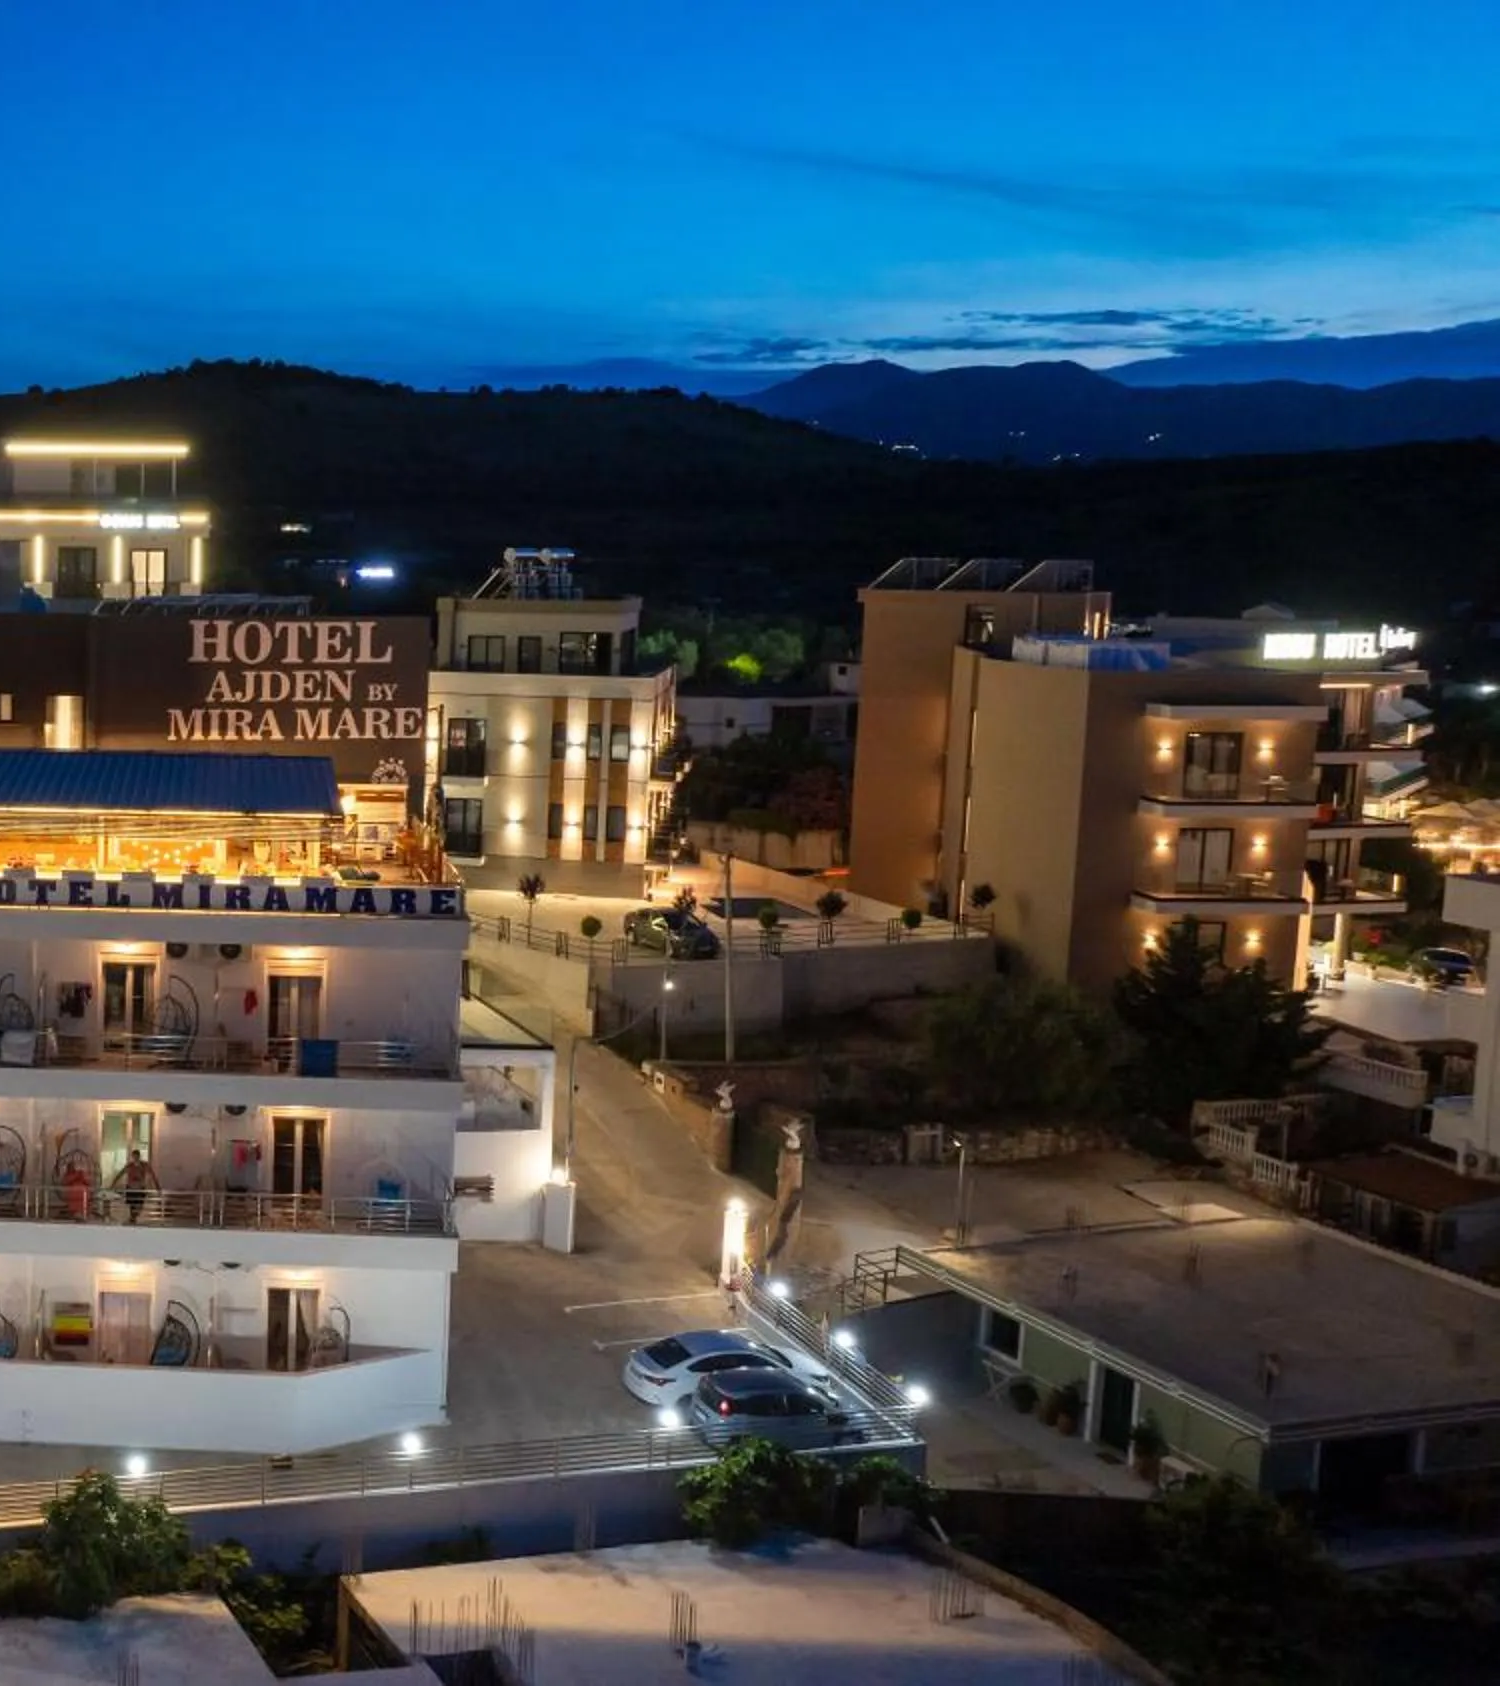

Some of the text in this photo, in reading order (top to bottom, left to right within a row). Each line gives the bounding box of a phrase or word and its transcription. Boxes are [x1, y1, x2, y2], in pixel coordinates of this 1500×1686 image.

[187, 619, 393, 665] HOTEL
[205, 670, 398, 703] AJDEN BY
[167, 707, 423, 741] MIRA MARE
